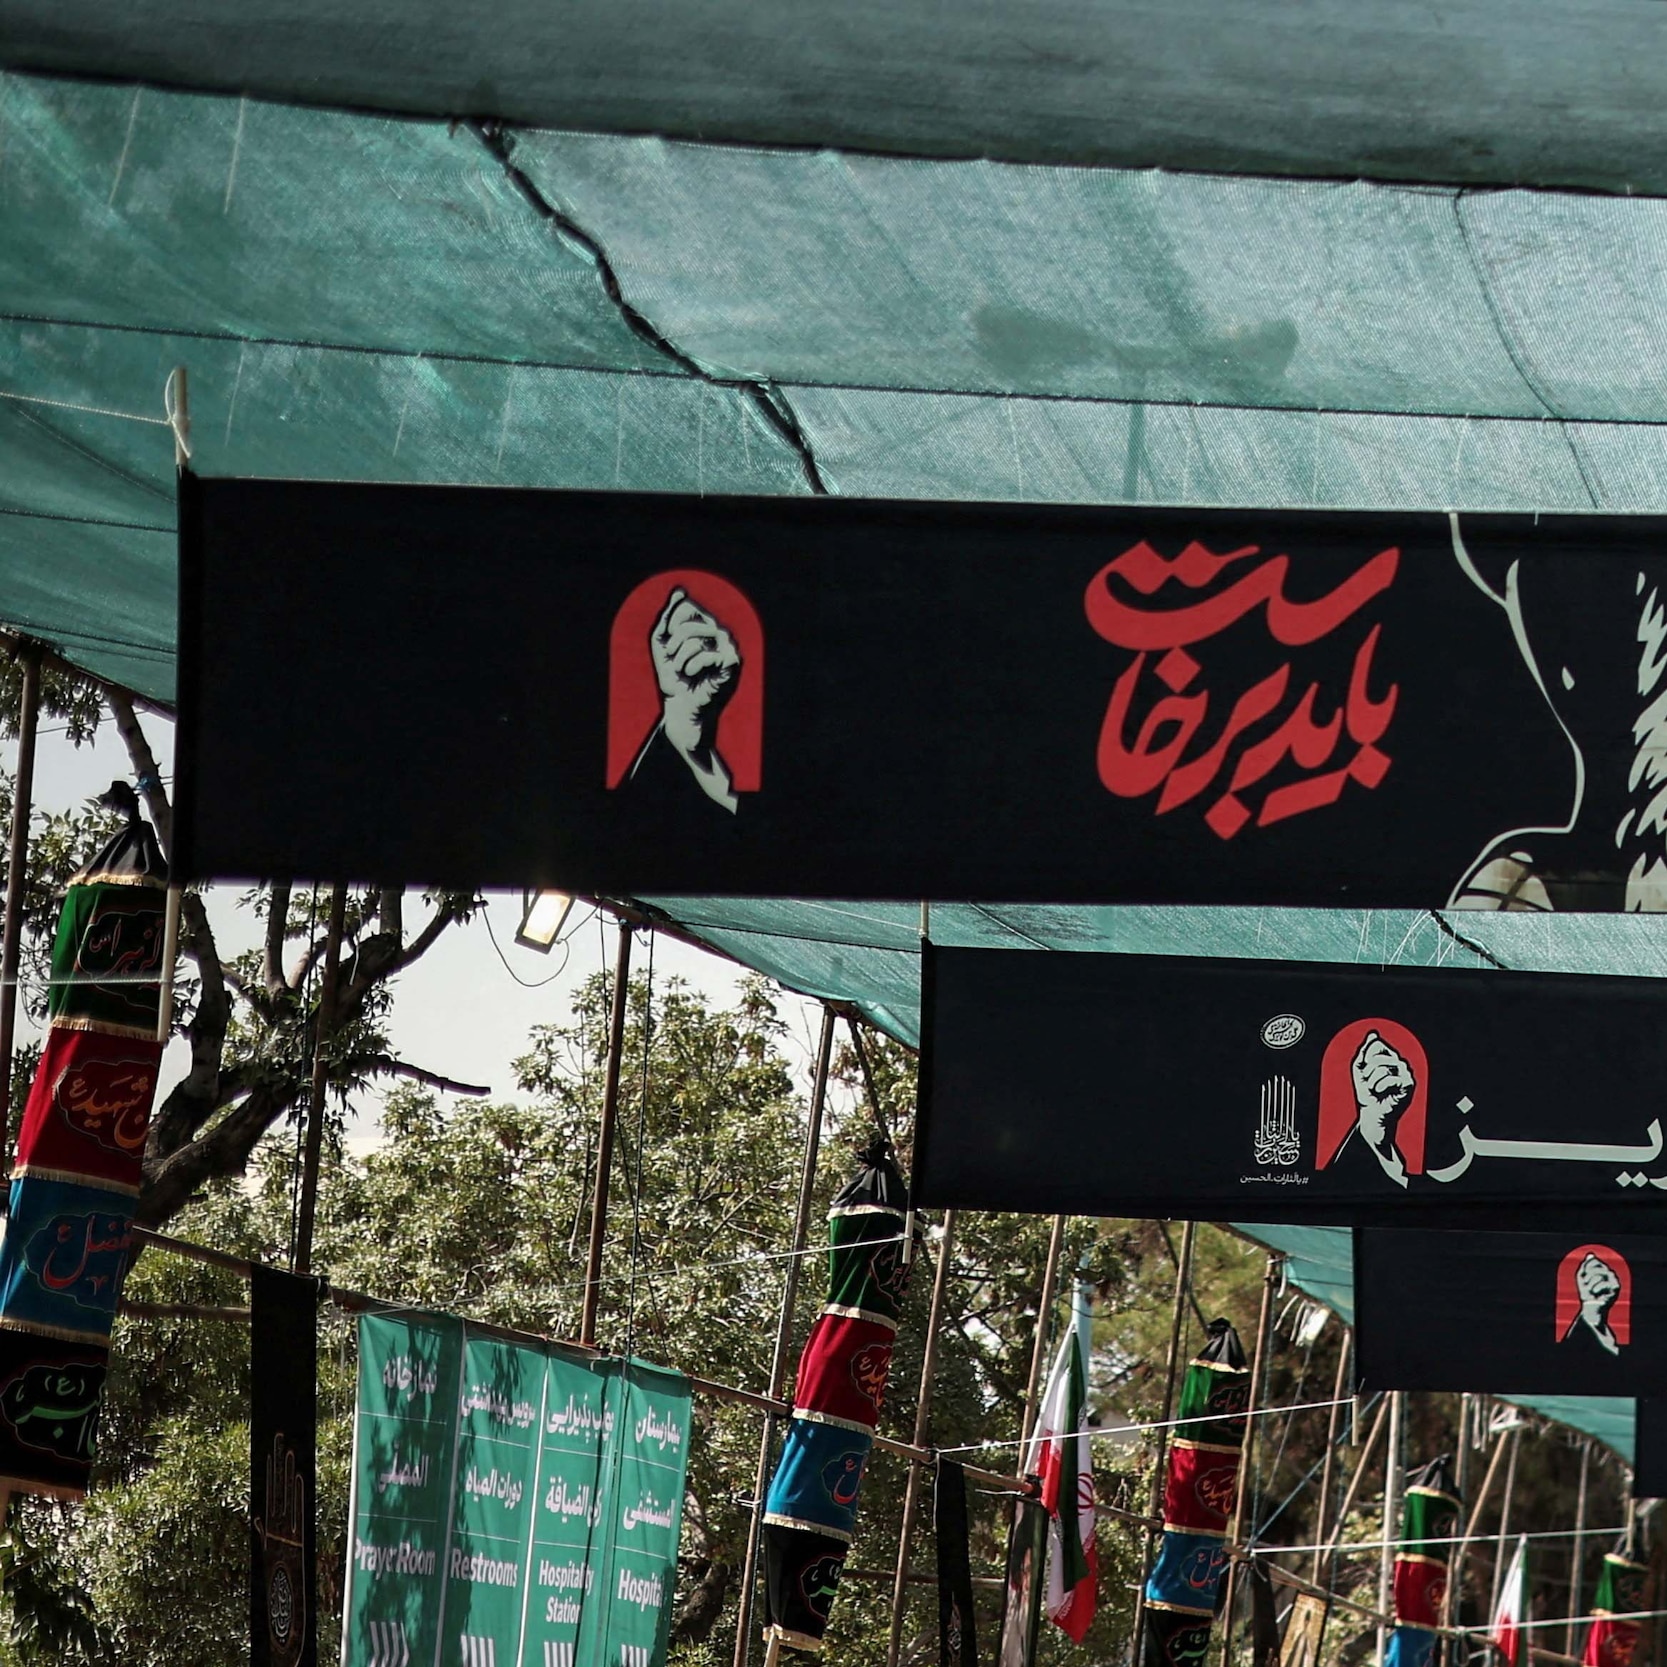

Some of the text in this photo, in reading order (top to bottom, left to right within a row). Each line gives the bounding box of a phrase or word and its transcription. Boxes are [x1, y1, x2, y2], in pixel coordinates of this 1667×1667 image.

[396, 1541, 437, 1576] Room
[450, 1547, 519, 1588] Restrooms
[539, 1560, 595, 1597] Hospitality
